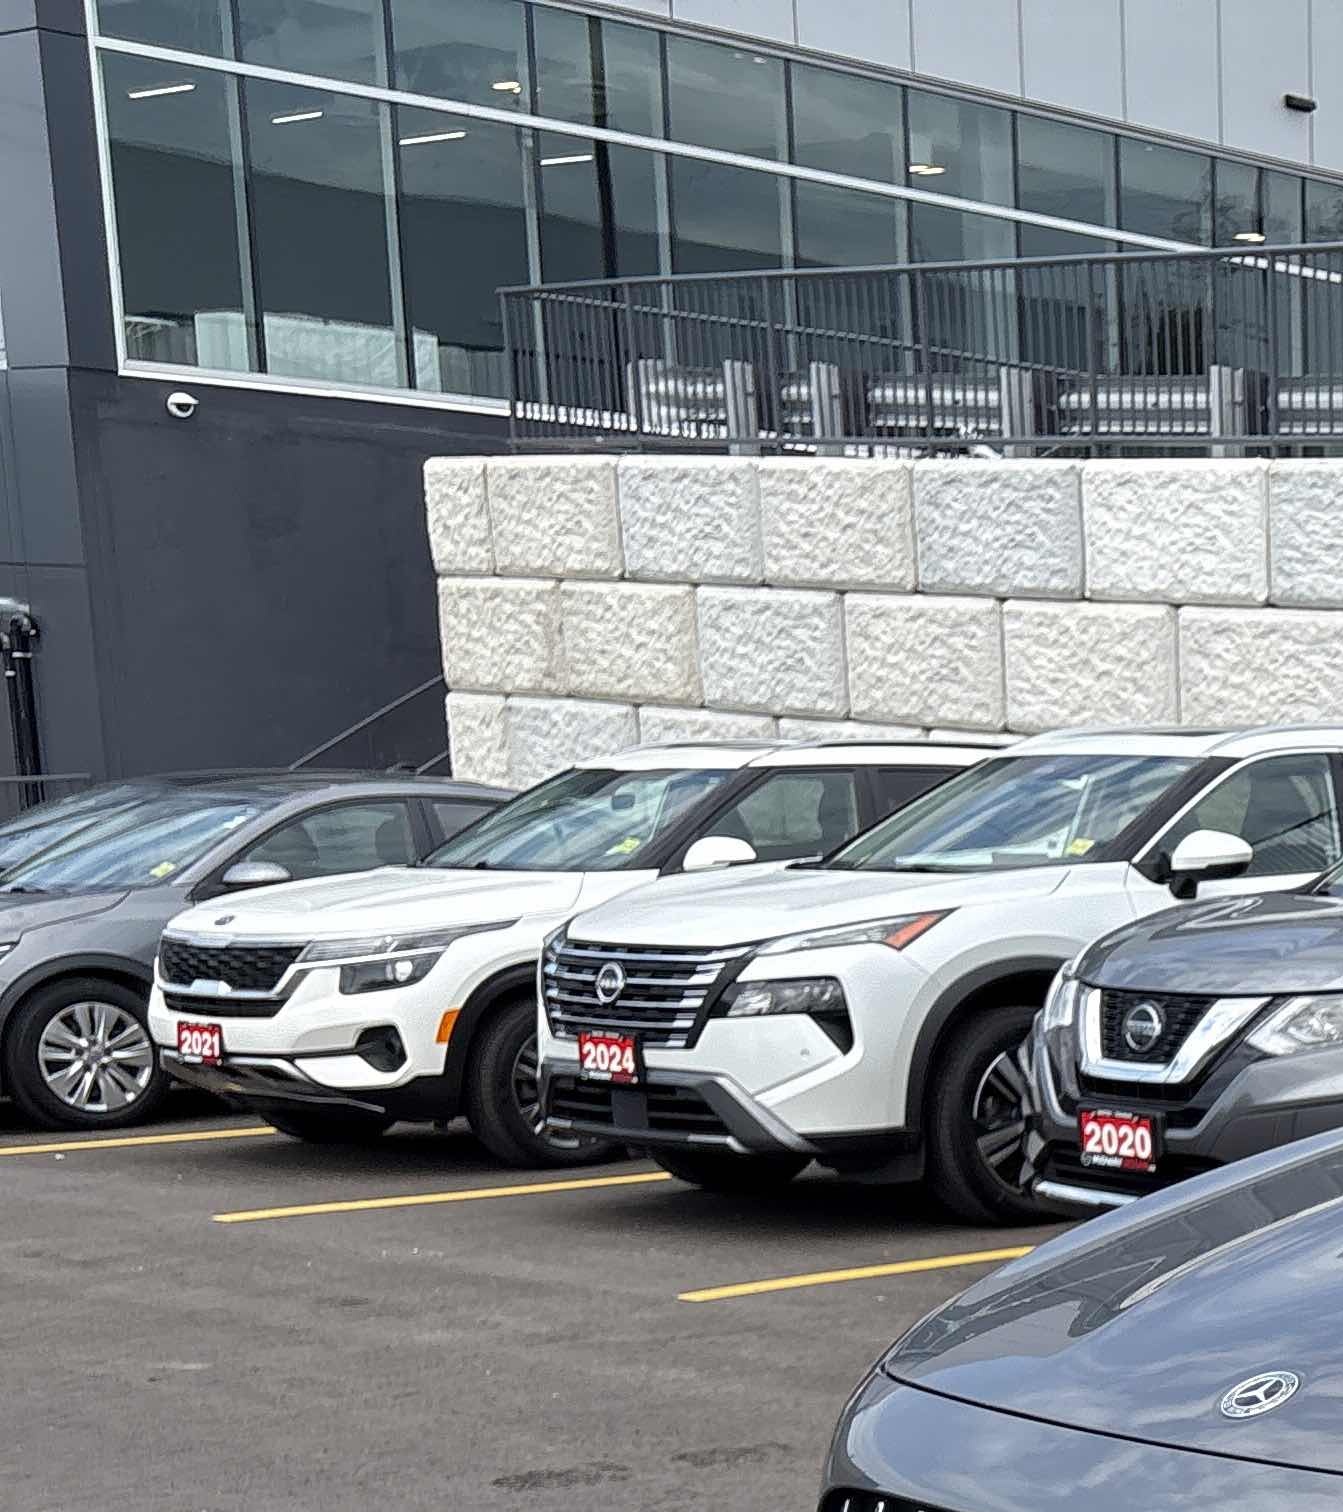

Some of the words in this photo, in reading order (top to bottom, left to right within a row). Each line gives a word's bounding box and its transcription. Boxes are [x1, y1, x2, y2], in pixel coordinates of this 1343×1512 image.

[181, 1029, 220, 1058] 2021
[582, 1041, 635, 1074] 2024
[1084, 1121, 1152, 1160] 2020
